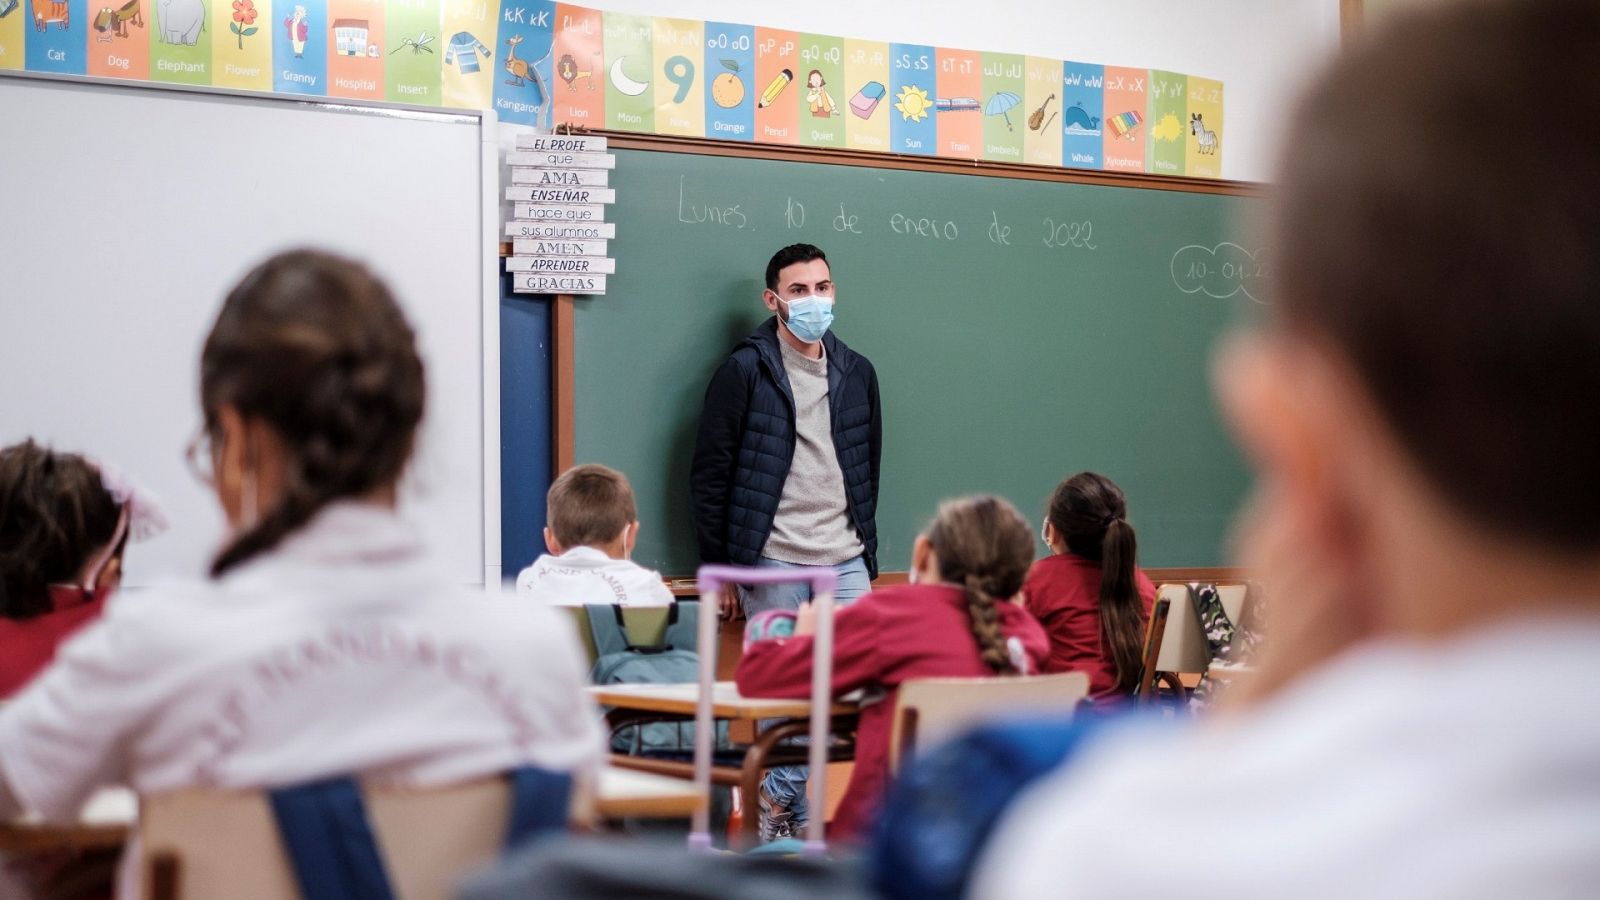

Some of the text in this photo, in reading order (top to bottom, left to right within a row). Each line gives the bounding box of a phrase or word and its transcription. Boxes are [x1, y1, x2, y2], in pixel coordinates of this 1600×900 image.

[505, 7, 550, 28] kK kK
[47, 49, 65, 61] Cat
[108, 55, 129, 69] Dog
[157, 59, 205, 73] Elephant
[225, 65, 260, 77] Flower
[283, 70, 316, 86] Granny
[335, 77, 376, 91] Hospital
[664, 55, 695, 104] 9
[398, 83, 428, 95] Insect
[497, 98, 540, 113] Kangaroo
[569, 107, 588, 118] Lion
[618, 112, 642, 124] Moon
[714, 121, 745, 134] Orange
[764, 126, 788, 137] Pencil
[811, 130, 833, 141] Quiet
[534, 139, 586, 151] EL PROFE
[905, 138, 922, 149] Sun
[950, 141, 969, 152] Train
[987, 144, 1019, 156] Umbrella
[547, 154, 573, 166] que
[1072, 153, 1094, 163] Whale
[1155, 160, 1177, 170] Yellow
[540, 172, 581, 185] AMA
[530, 189, 589, 202] ENSEÑAR
[528, 207, 592, 221] hace que
[784, 196, 805, 229] 10
[832, 201, 863, 234] de
[890, 213, 958, 240] enero
[988, 209, 1011, 246] de
[1042, 216, 1097, 250] 2022
[521, 226, 599, 238] sus alumnos
[536, 242, 585, 255] AMEN
[530, 259, 590, 272] APRENDER
[527, 277, 594, 290] GRACIAS
